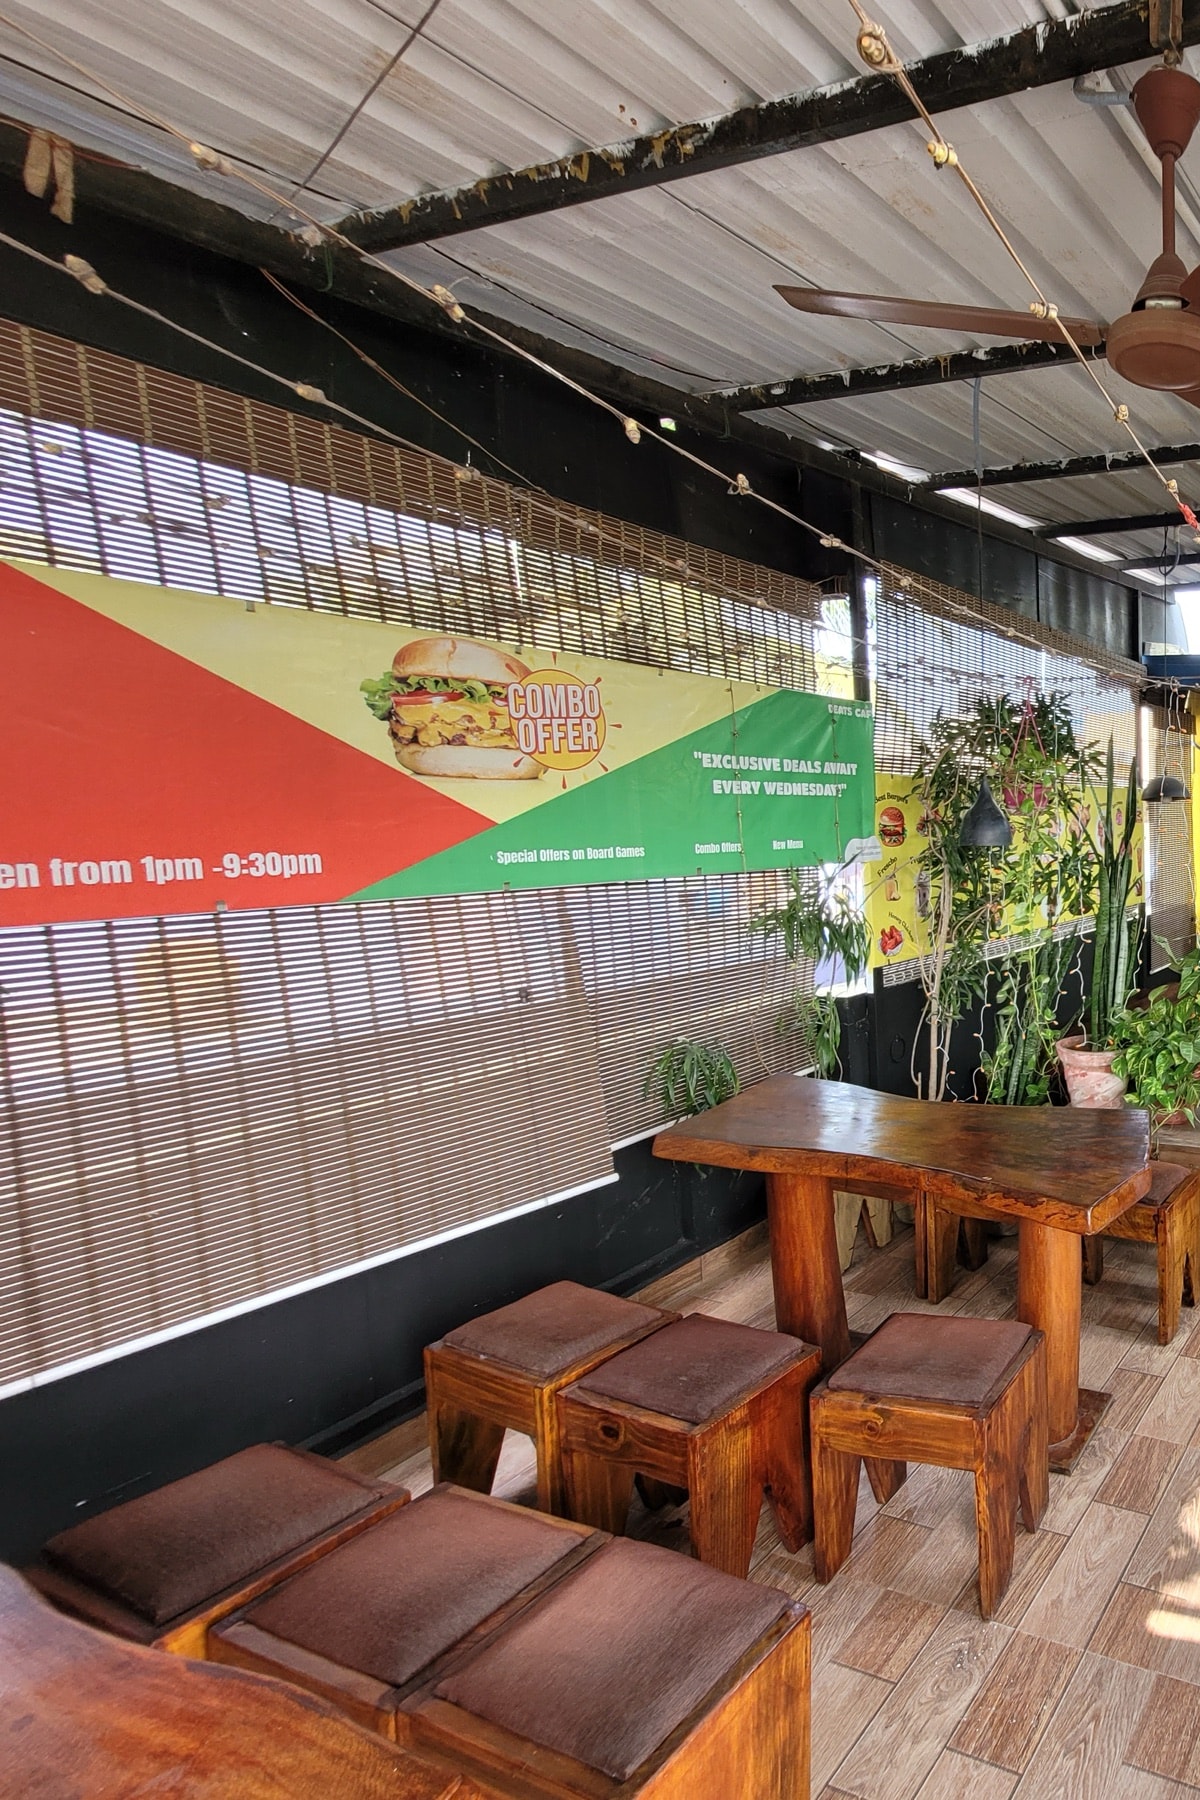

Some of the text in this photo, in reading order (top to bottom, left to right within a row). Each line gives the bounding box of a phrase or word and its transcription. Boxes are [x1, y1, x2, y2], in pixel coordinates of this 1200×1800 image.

[507, 682, 601, 720] COMBO
[855, 708, 873, 718] CAF
[517, 718, 600, 755] OFFER
[783, 759, 822, 774] DEALS
[824, 762, 857, 775] AWAIT
[713, 779, 761, 795] EVERY
[497, 846, 645, 865] Special Offers on Board Games
[695, 841, 742, 854] Combo Offers
[50, 858, 133, 886] from
[140, 856, 204, 885] 1pm
[212, 851, 323, 878] -9:30pm
